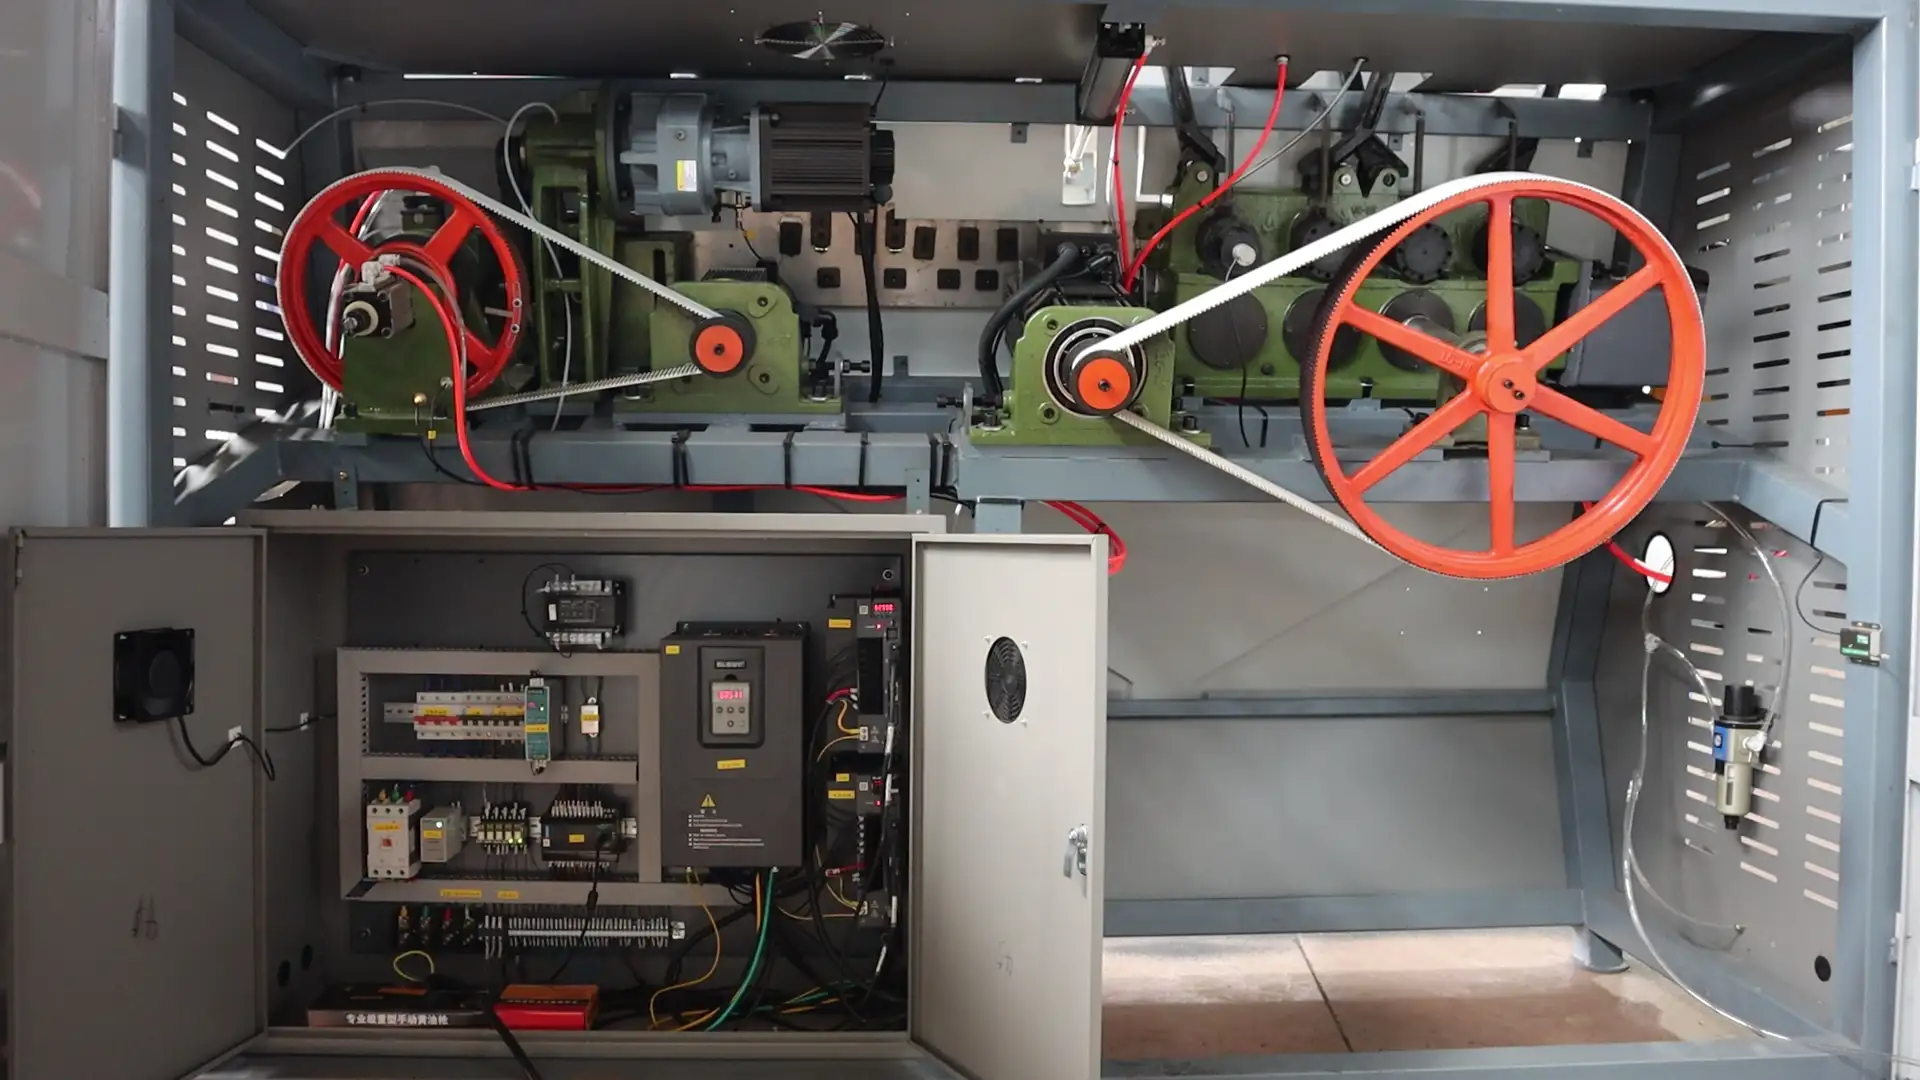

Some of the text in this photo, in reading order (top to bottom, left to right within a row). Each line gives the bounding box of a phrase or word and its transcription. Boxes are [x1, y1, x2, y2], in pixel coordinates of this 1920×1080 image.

[345, 1013, 449, 1026] 专业级重型手动黄油枪
